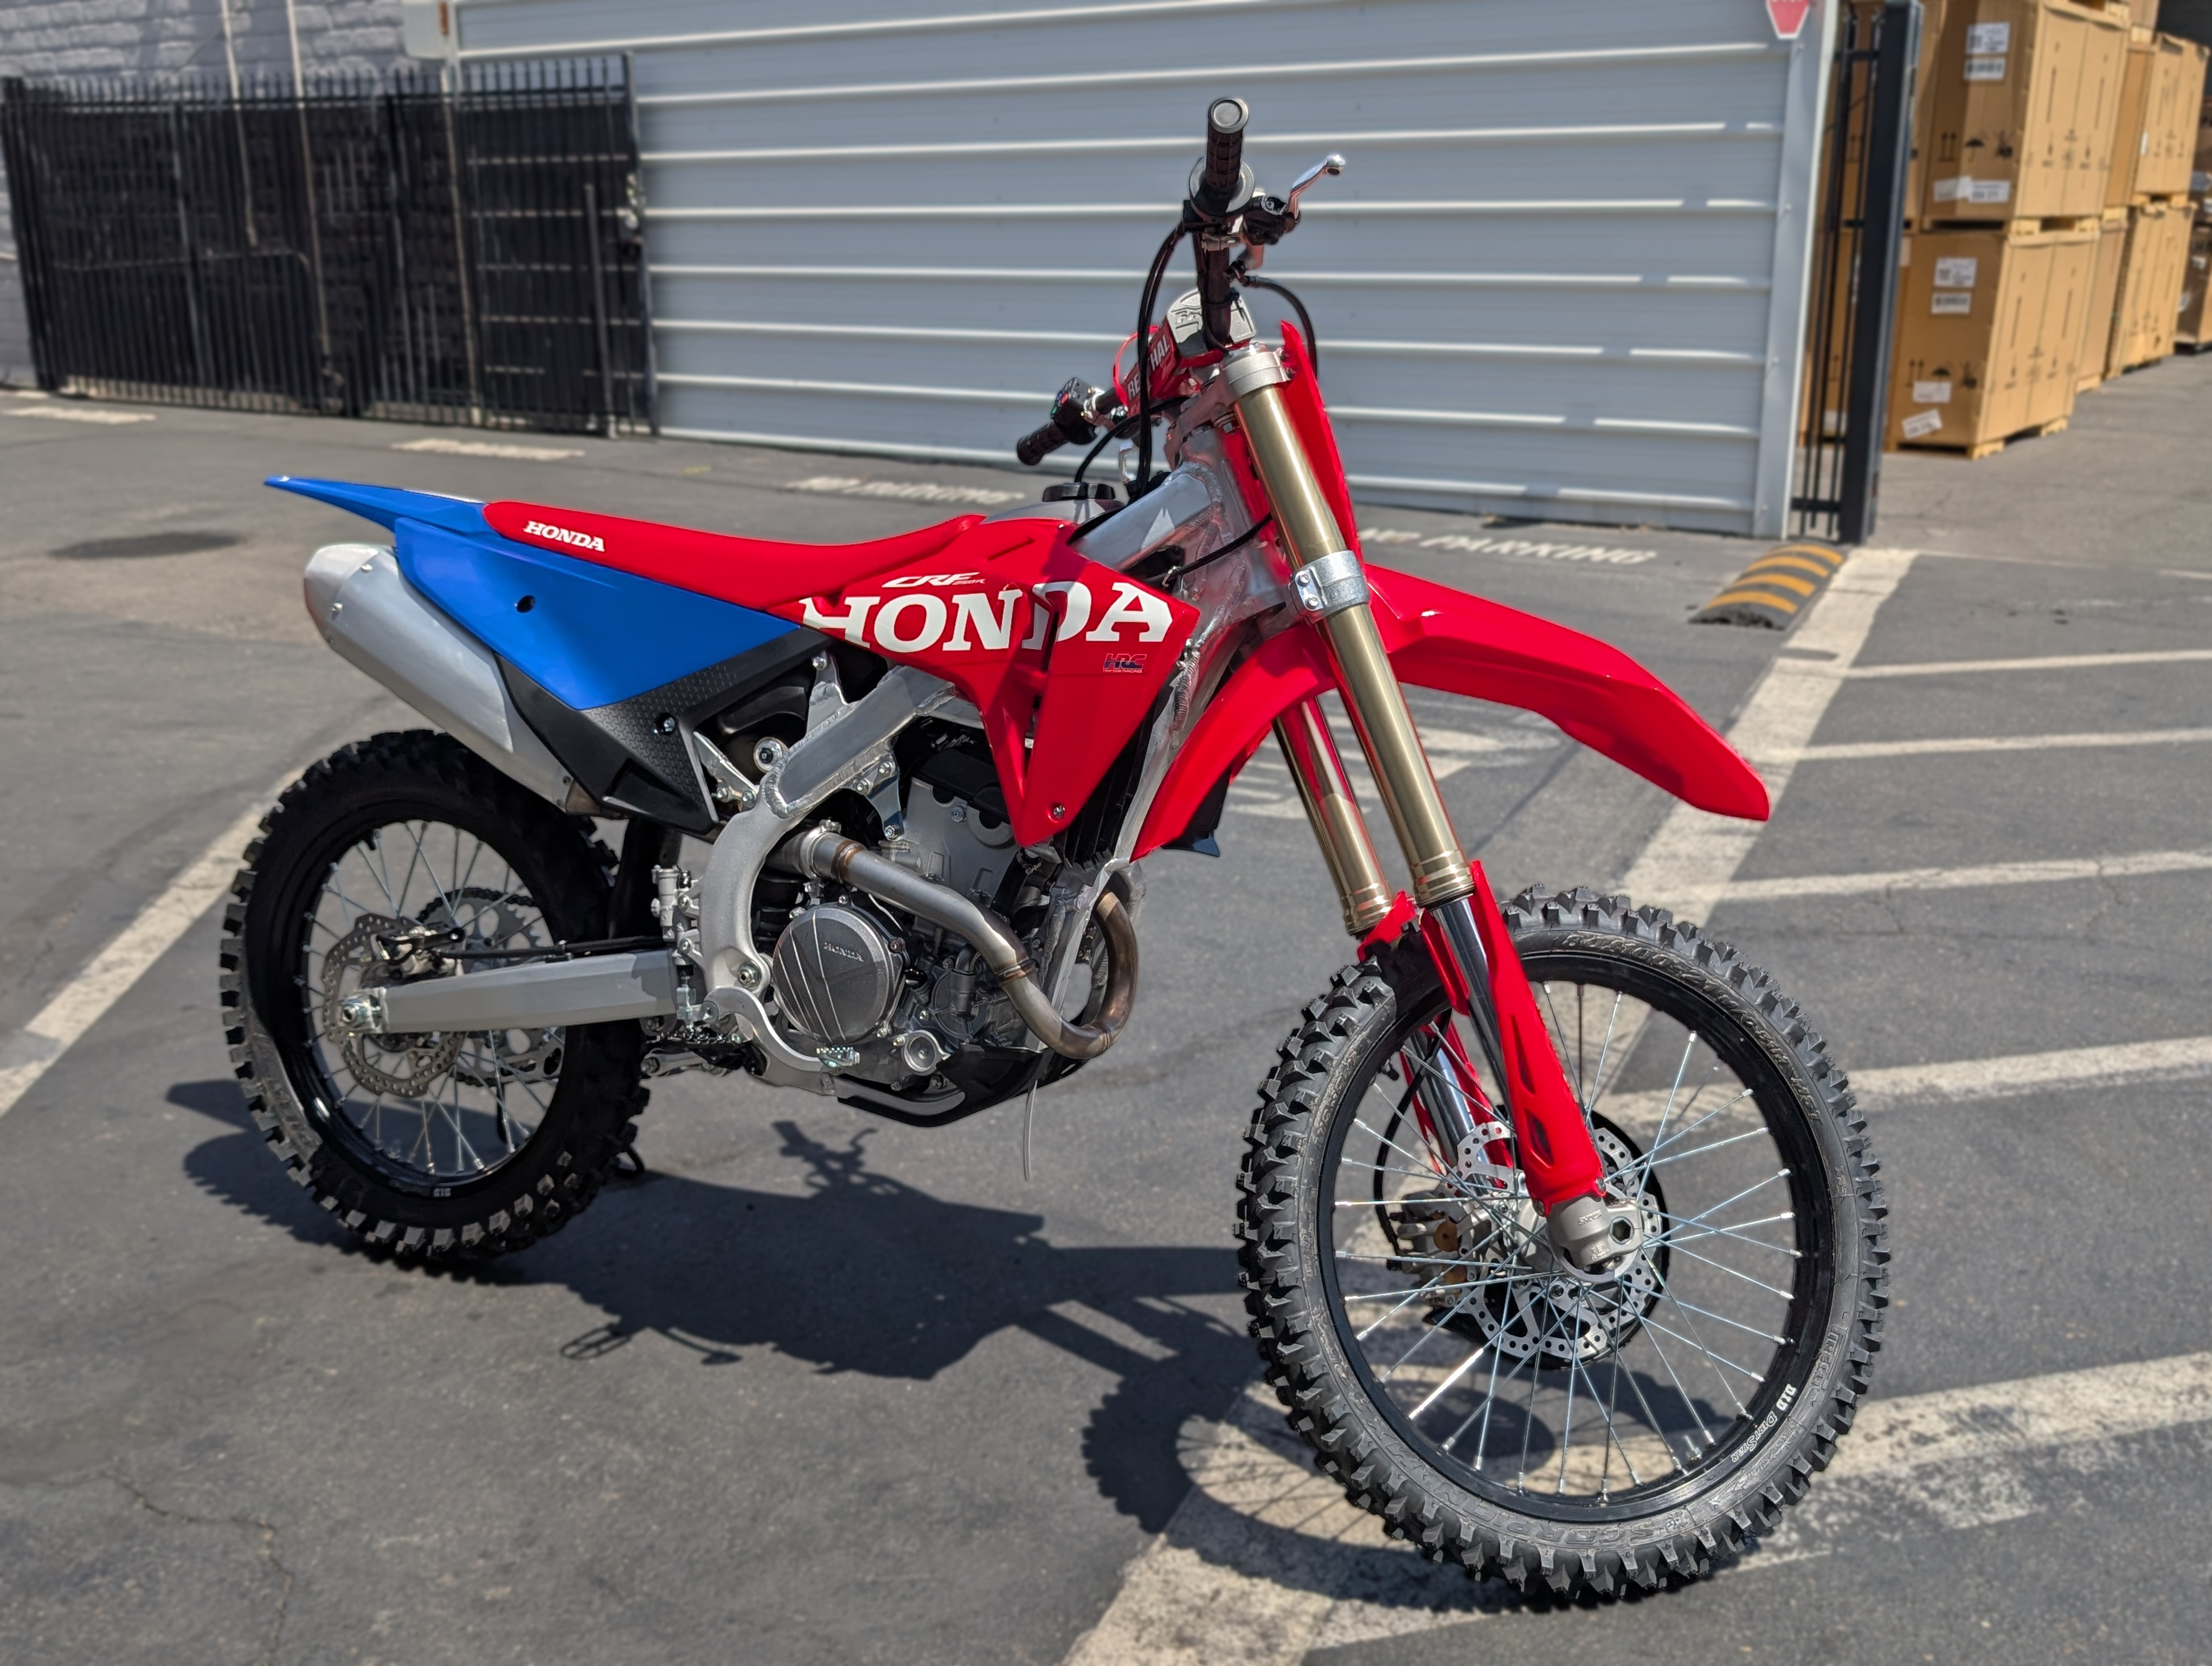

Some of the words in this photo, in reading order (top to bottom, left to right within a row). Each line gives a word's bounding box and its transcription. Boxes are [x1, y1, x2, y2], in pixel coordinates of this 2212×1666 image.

[1128, 334, 1169, 401] REHAL
[524, 521, 605, 552] HONDA
[882, 572, 981, 588] CRF
[799, 581, 1173, 653] HONDA
[1103, 653, 1147, 670] HRC
[824, 941, 865, 963] HONDA
